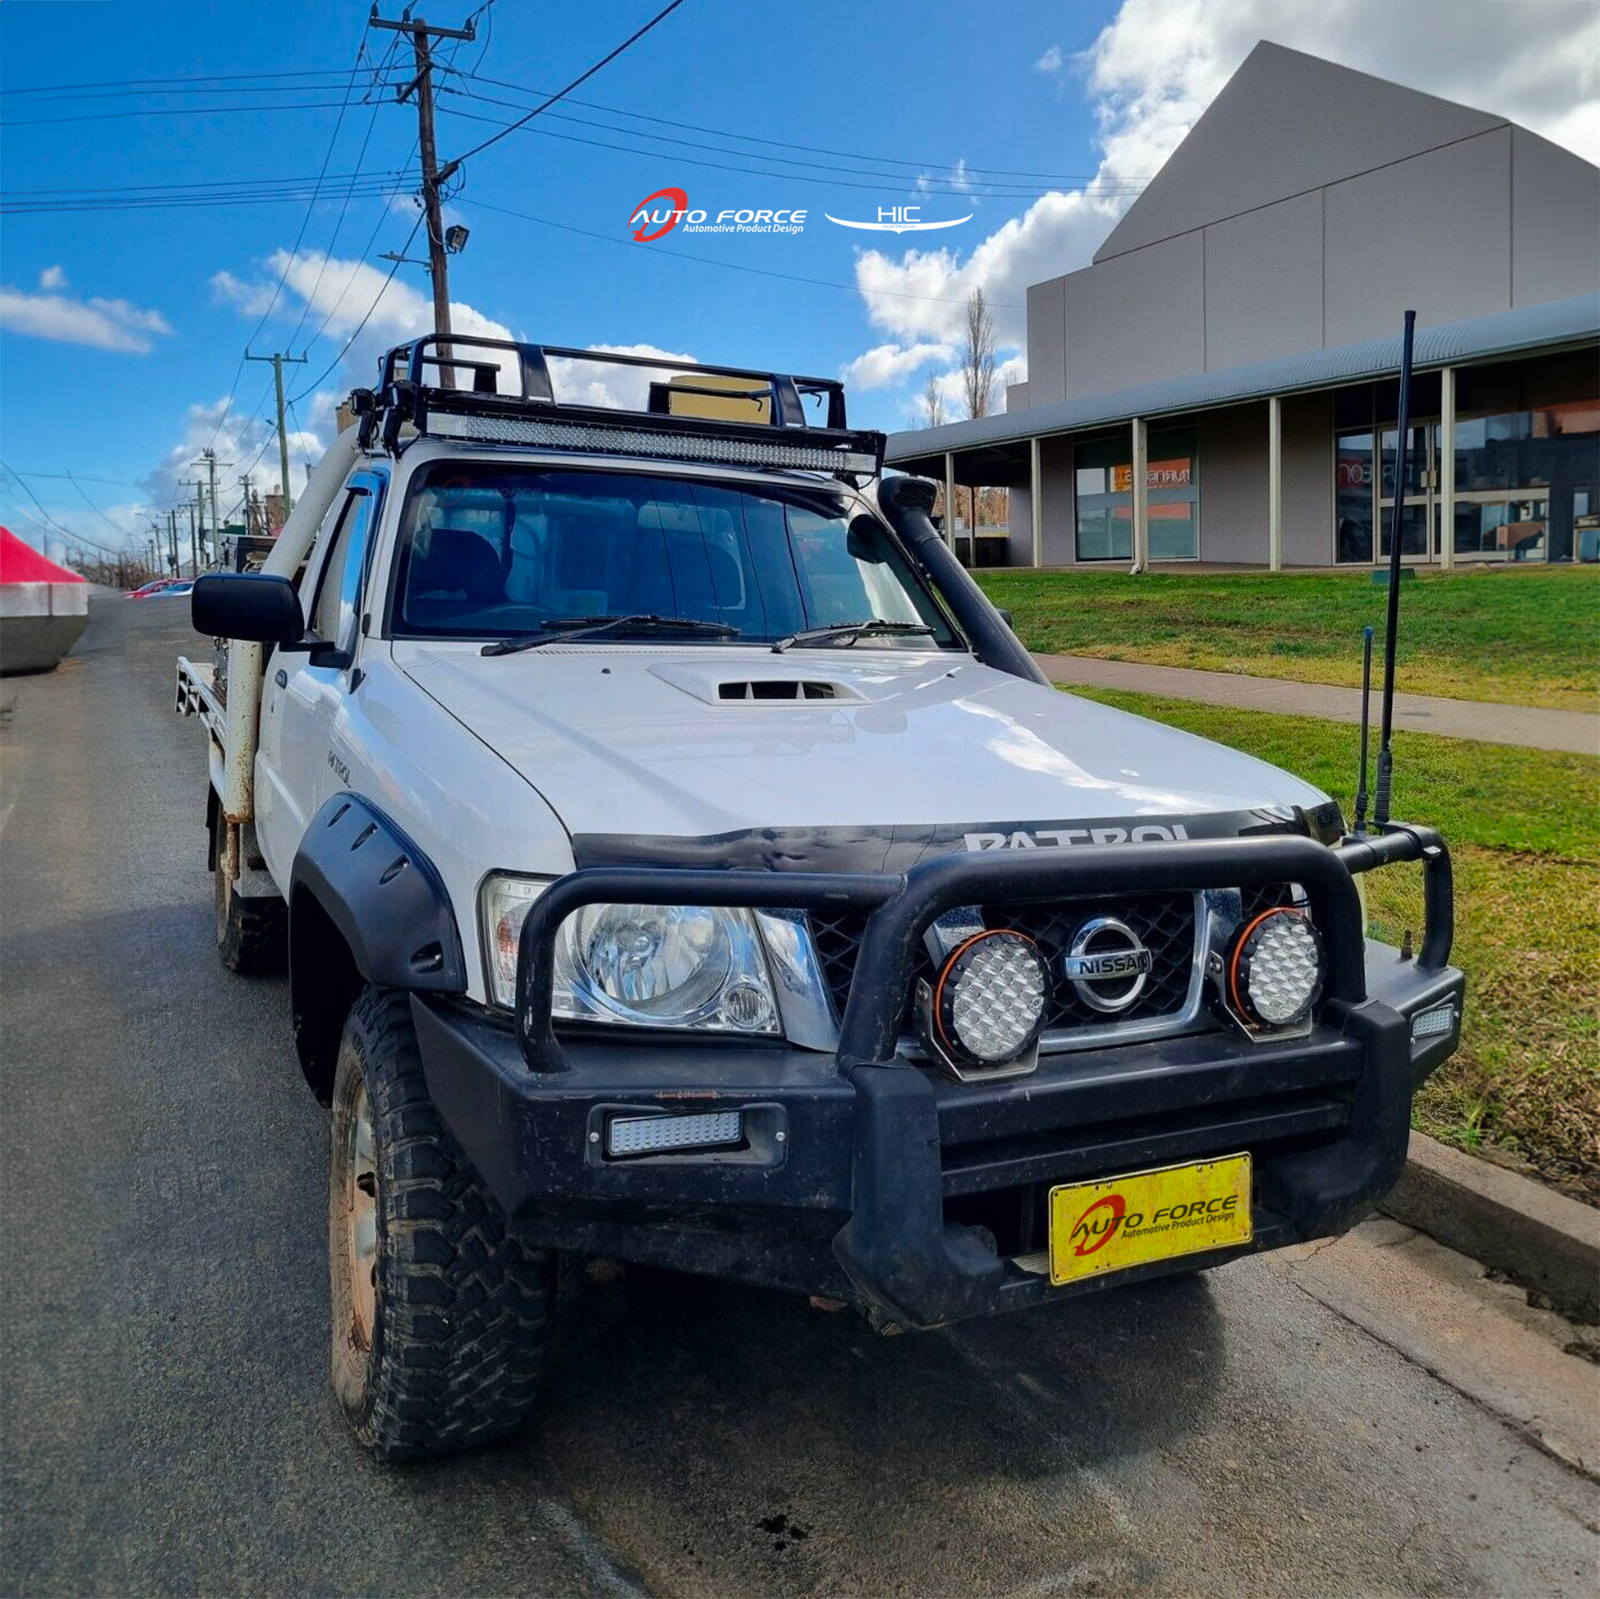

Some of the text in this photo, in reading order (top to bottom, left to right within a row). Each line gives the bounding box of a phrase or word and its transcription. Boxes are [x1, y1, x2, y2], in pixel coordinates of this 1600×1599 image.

[1078, 949, 1151, 976] NISSAN
[1070, 1194, 1240, 1240] AUTO FORCE
[1120, 1210, 1235, 1240] Automotive Product Design
